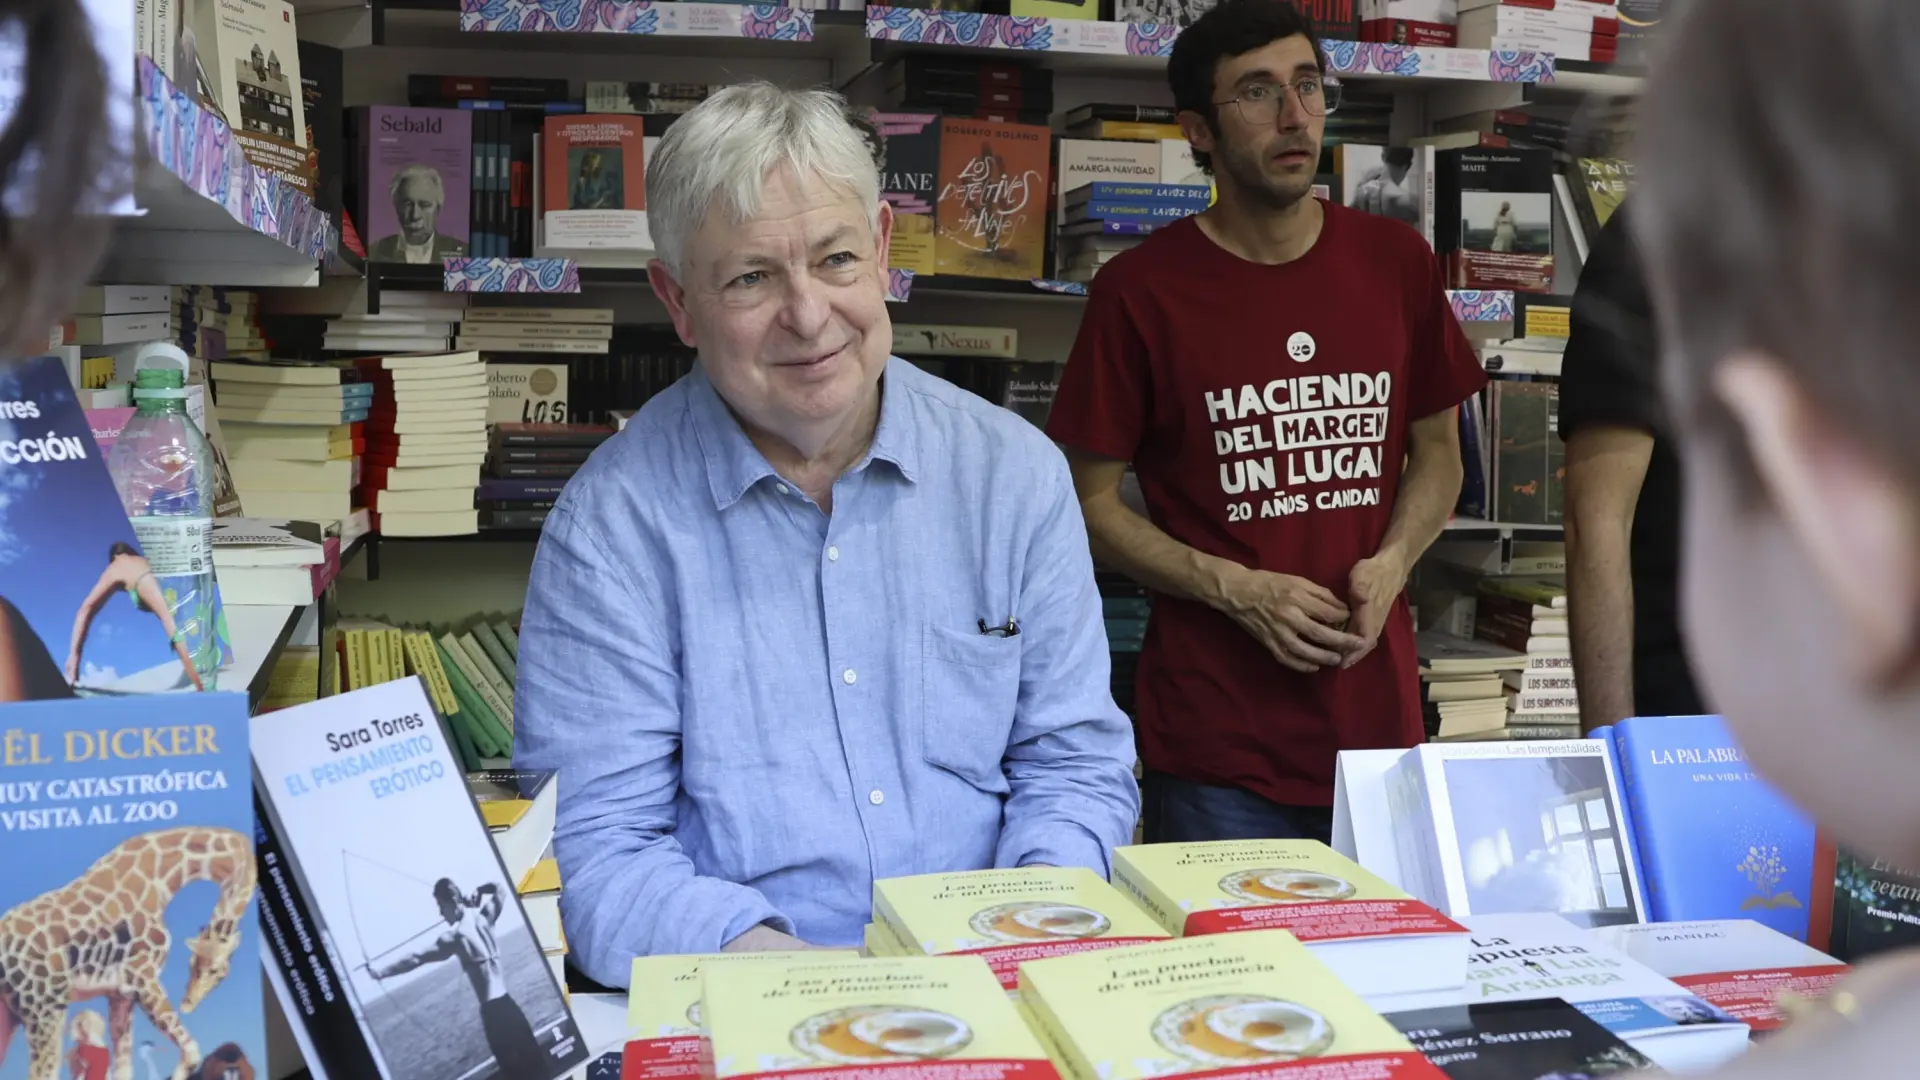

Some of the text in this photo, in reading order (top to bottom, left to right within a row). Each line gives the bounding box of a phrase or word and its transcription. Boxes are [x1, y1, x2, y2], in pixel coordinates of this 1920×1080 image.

[380, 114, 442, 134] Sebald
[944, 125, 992, 138] ROBERTO
[957, 156, 996, 181] LOS
[1069, 164, 1155, 175] AMARGA NAVIDAD
[1461, 164, 1487, 172] MAITE
[881, 172, 933, 191] JANE
[937, 170, 1042, 214] DETECTIVES
[1156, 188, 1168, 197] LA
[1169, 188, 1186, 198] VOZ
[1188, 189, 1203, 199] DEL
[1152, 207, 1164, 216] LA
[1165, 207, 1182, 217] VOZ
[940, 331, 992, 350] Nexus
[1204, 371, 1391, 423] HACIENDO
[521, 398, 567, 424] LOS
[1214, 412, 1386, 456] DEL MARGEN
[1219, 445, 1383, 495] UN LUGA
[1227, 501, 1252, 522] 20
[1260, 491, 1309, 518] AÑOS
[1531, 658, 1544, 669] LOS
[1528, 678, 1570, 690] LOS SURCOS
[1522, 698, 1564, 710] LOS SURCOS
[325, 711, 425, 754] Sara Torres
[63, 723, 221, 763] DICKER
[1528, 743, 1601, 756] tempestálidas
[285, 733, 435, 797] EL PENSAMIENTO
[1651, 749, 1675, 765] LA
[46, 768, 230, 800] CATASTRÓFICA
[368, 758, 446, 800] ERÓTICO
[1693, 772, 1741, 782] UNA VIDA
[1, 799, 180, 831] VISITA AL ZOO
[1220, 849, 1289, 858] pruebas
[1229, 854, 1311, 862] inocencia
[932, 885, 1077, 901] de mi inocencia
[944, 880, 1054, 892] Las pruebas
[1867, 905, 1897, 920] Premio
[264, 852, 335, 1003] El pensamiento erótico
[1656, 931, 1728, 943] MANIAC
[1470, 936, 1511, 948] La
[1111, 956, 1247, 979] Las pruebas
[1547, 956, 1622, 971] Luis
[782, 973, 927, 988] Las pruebas
[1098, 964, 1276, 993] de mi inocencia
[1481, 970, 1625, 997] Arsuaga
[289, 967, 316, 1016] erótico
[761, 981, 952, 1000] de mi inocencia
[1479, 1027, 1573, 1045] Serrano
